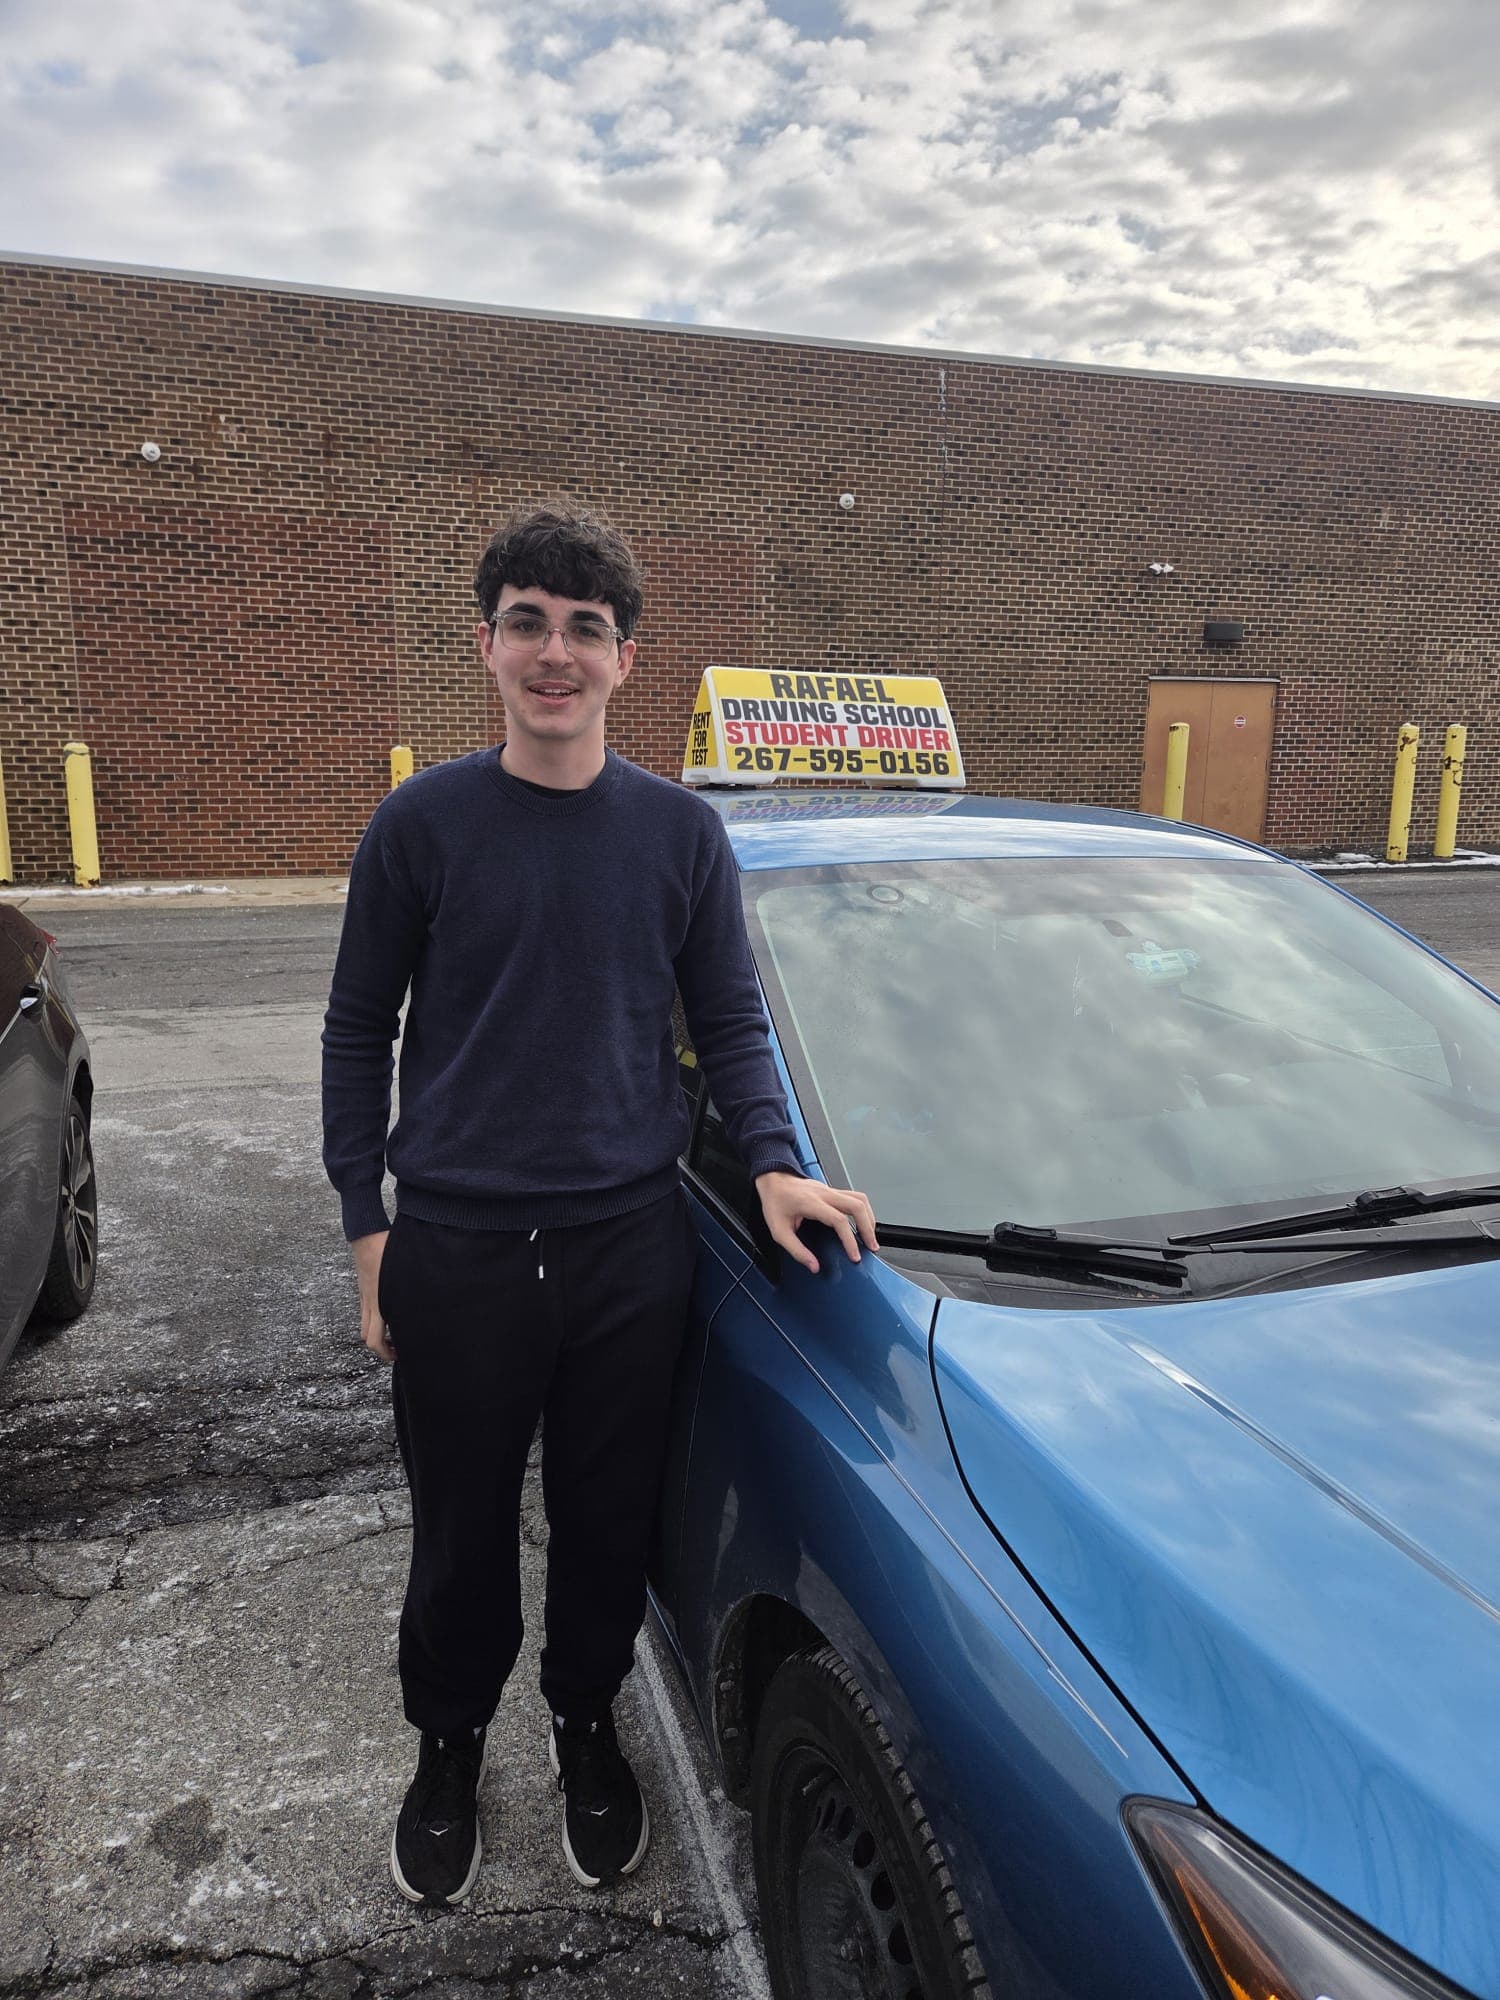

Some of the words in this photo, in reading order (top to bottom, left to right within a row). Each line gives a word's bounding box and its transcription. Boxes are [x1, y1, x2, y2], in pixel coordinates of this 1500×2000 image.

[770, 674, 895, 703] RAFAEL
[693, 712, 711, 729] RENT
[721, 698, 837, 723] DRIVING
[846, 704, 947, 728] SCHOOL
[694, 730, 707, 747] FOR
[725, 722, 848, 747] STUDENT
[858, 725, 952, 750] DRIVER
[692, 748, 708, 765] TEST
[734, 747, 950, 776] 267-595-0156
